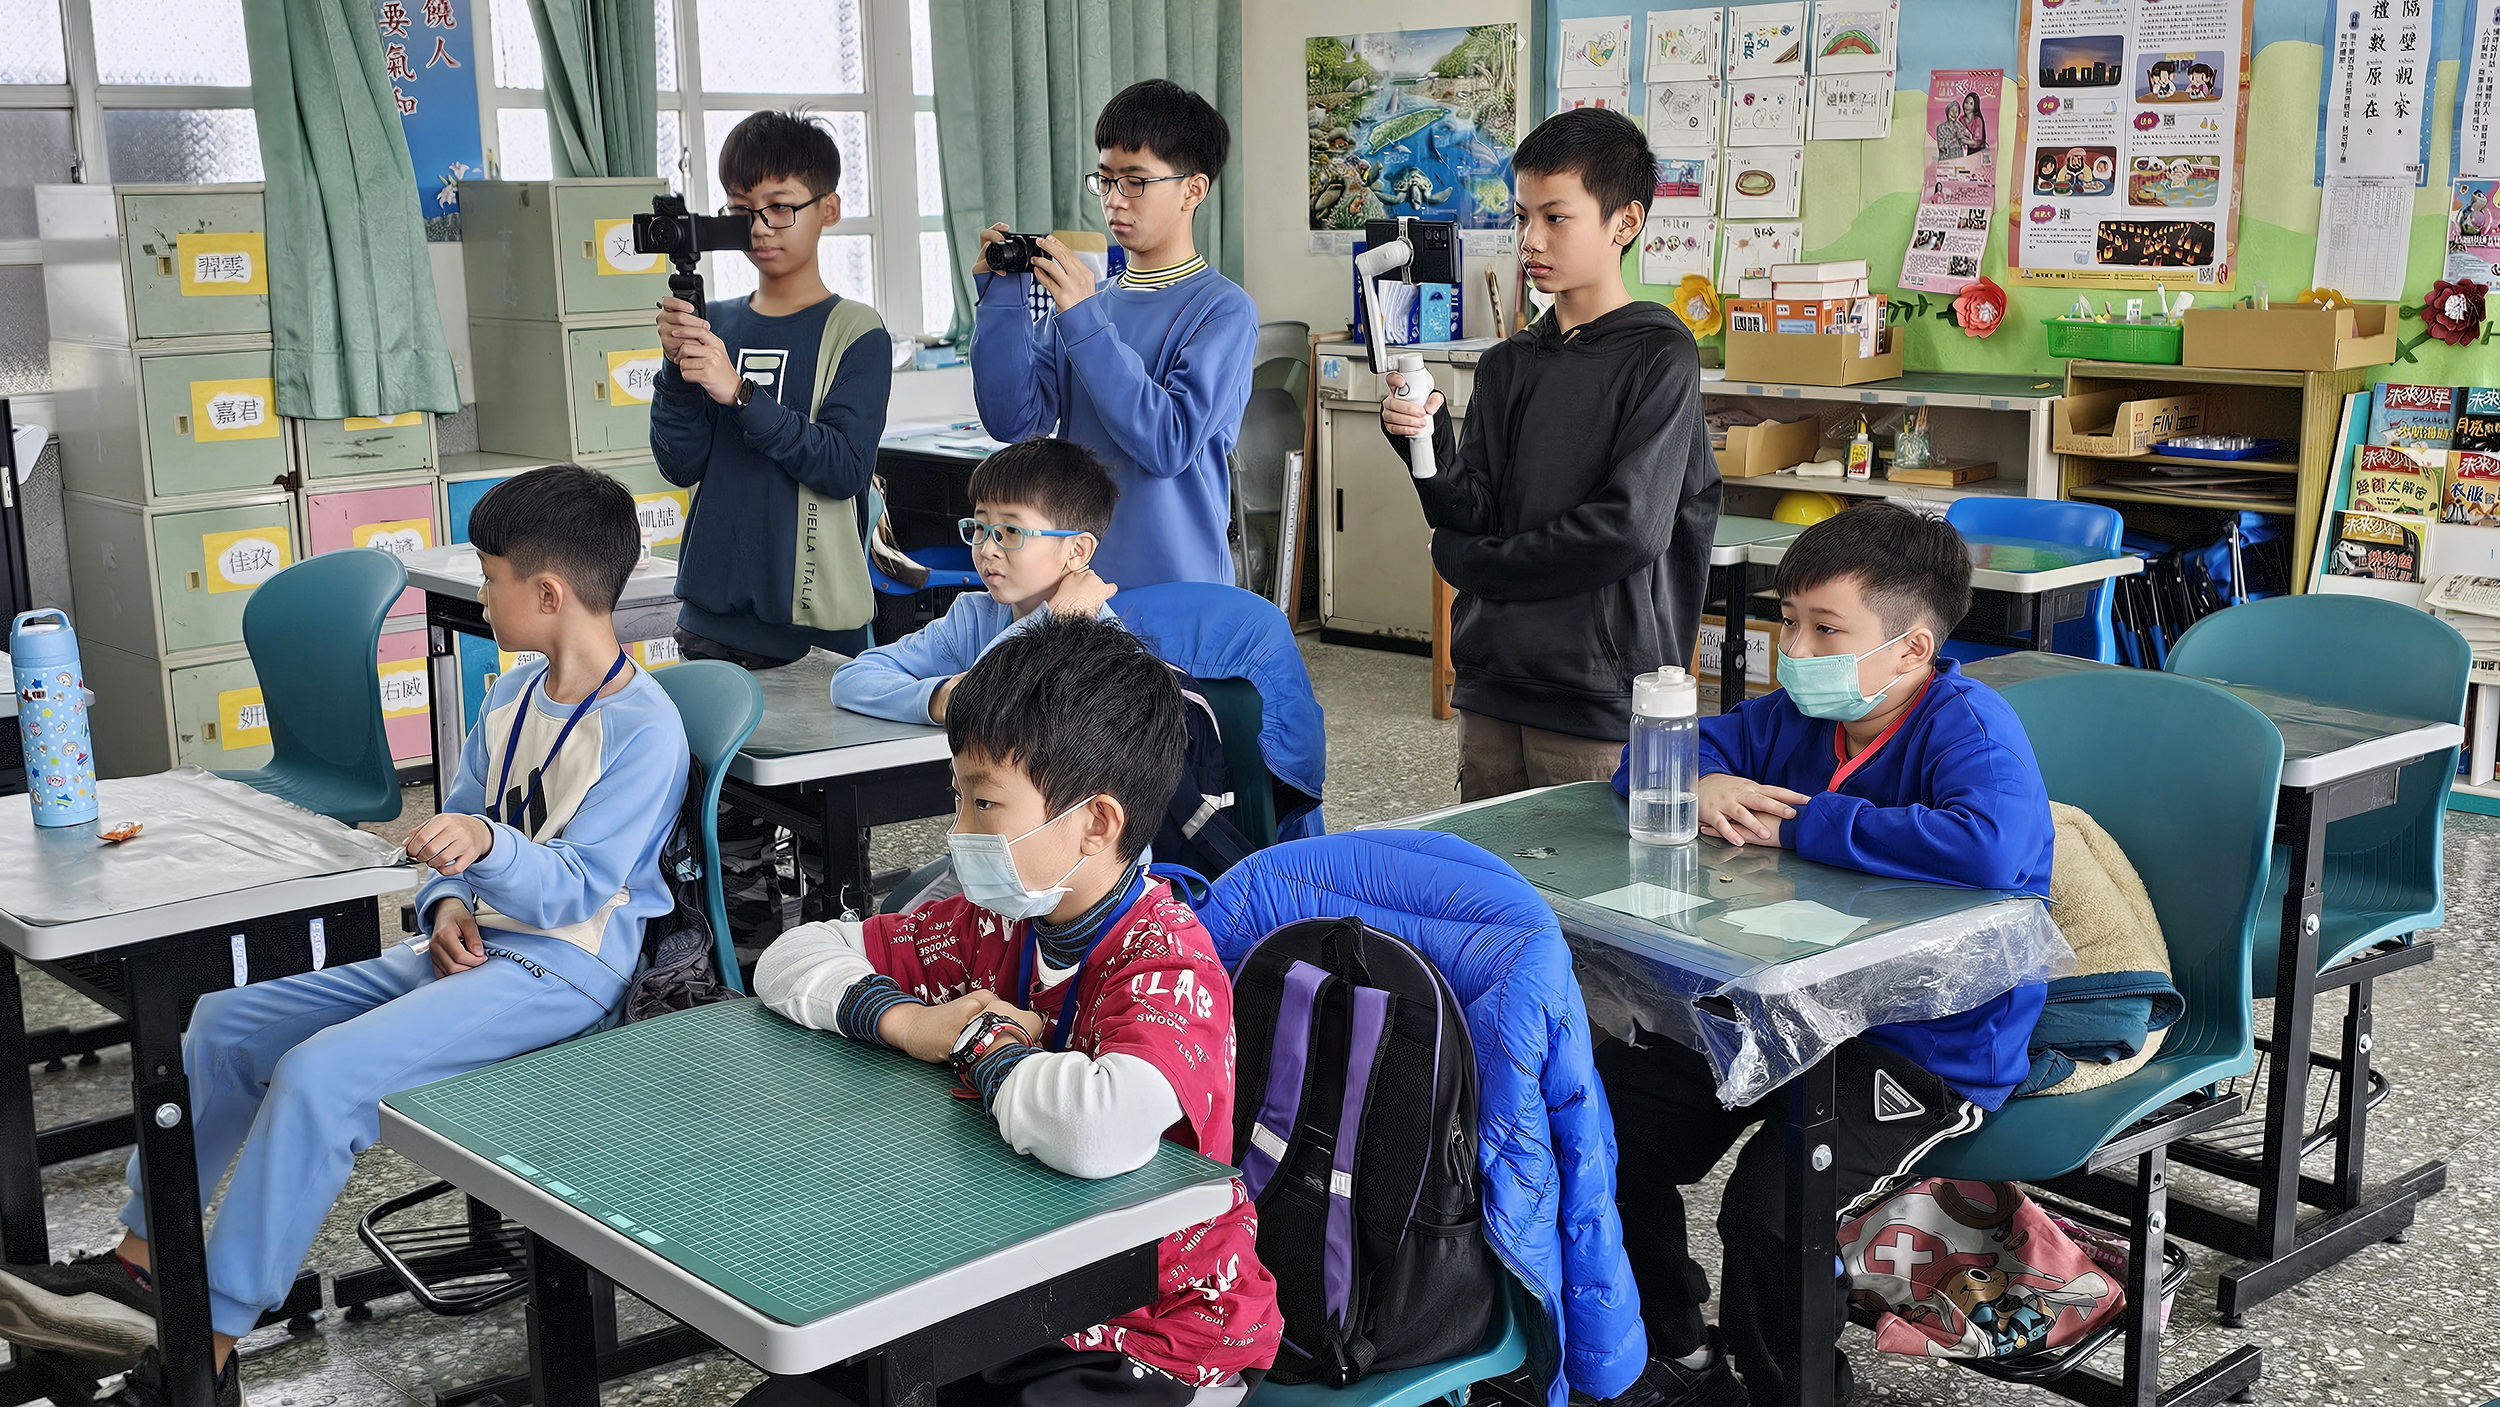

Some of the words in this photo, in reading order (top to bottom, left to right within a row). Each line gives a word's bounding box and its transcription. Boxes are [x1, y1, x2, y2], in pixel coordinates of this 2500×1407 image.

[612, 236, 636, 257] 文
[2385, 385, 2452, 409] 未來少年
[2467, 388, 2500, 411] 未來
[213, 399, 259, 425] 嘉君
[2152, 413, 2174, 433] FIN
[2398, 423, 2454, 441] 大航海時
[806, 502, 818, 553] BIELLA
[2342, 515, 2402, 541] 未來少年
[801, 562, 815, 610] ITALIA
[240, 704, 267, 729] 妍
